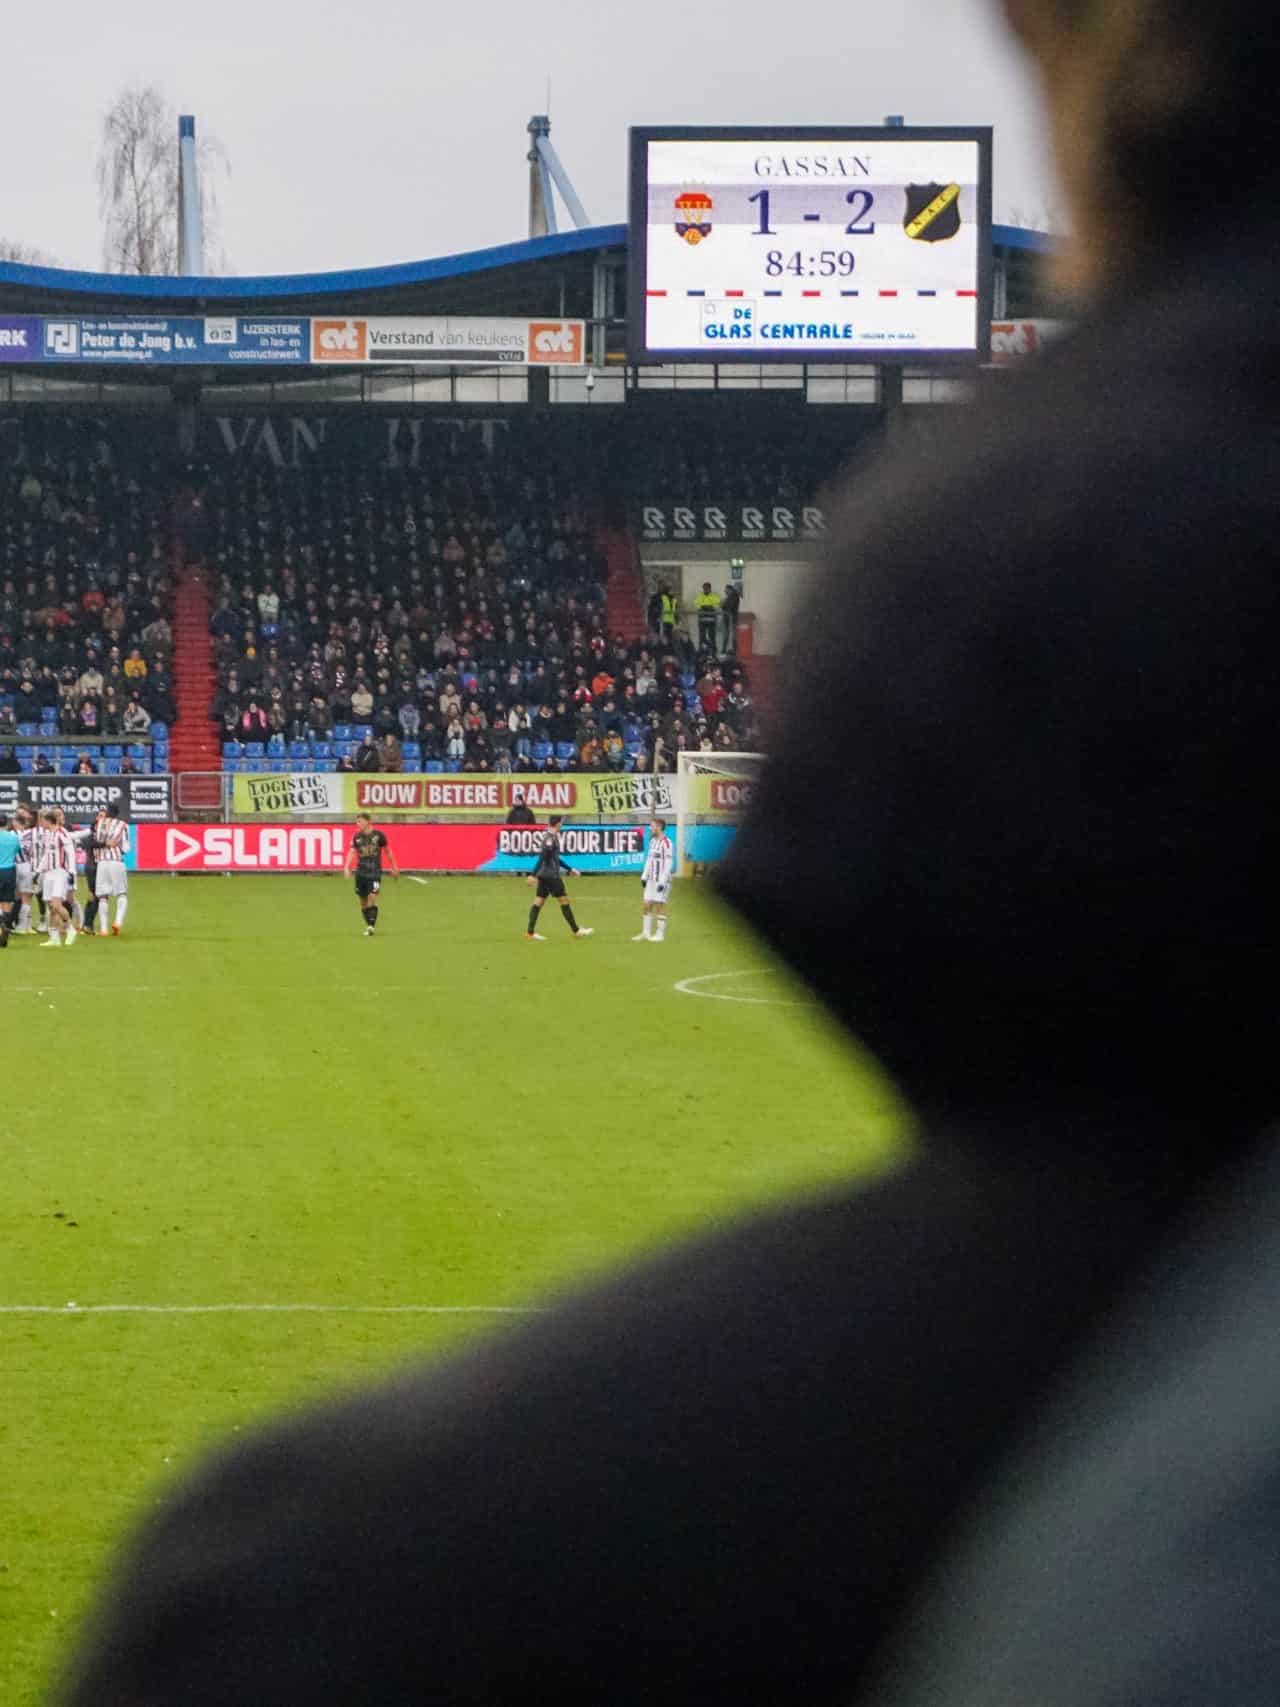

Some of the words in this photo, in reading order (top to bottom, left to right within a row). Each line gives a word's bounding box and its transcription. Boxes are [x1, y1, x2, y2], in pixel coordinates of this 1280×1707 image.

[754, 156, 872, 177] GASSAN
[748, 189, 777, 235] 1
[845, 189, 876, 235] 2
[765, 250, 855, 277] 84:59
[734, 308, 752, 320] DE
[369, 330, 433, 345] Verstand
[439, 334, 463, 345] van
[468, 328, 524, 346] keukens
[705, 324, 752, 339] GLAS
[760, 324, 853, 339] CENTRALE
[82, 332, 115, 347] Peter
[120, 332, 135, 347] de
[139, 333, 170, 352] Jong
[27, 786, 121, 802] TRICORP
[131, 791, 167, 800] TRICORP
[251, 775, 321, 796] LOGISTIC
[362, 785, 417, 804] JOUW
[429, 785, 498, 804] BETERE
[511, 784, 570, 804] BAAN
[253, 788, 325, 812] FORCE
[203, 828, 343, 865] SLAM!
[500, 830, 544, 852] BOOS
[604, 831, 638, 852] LIFE
